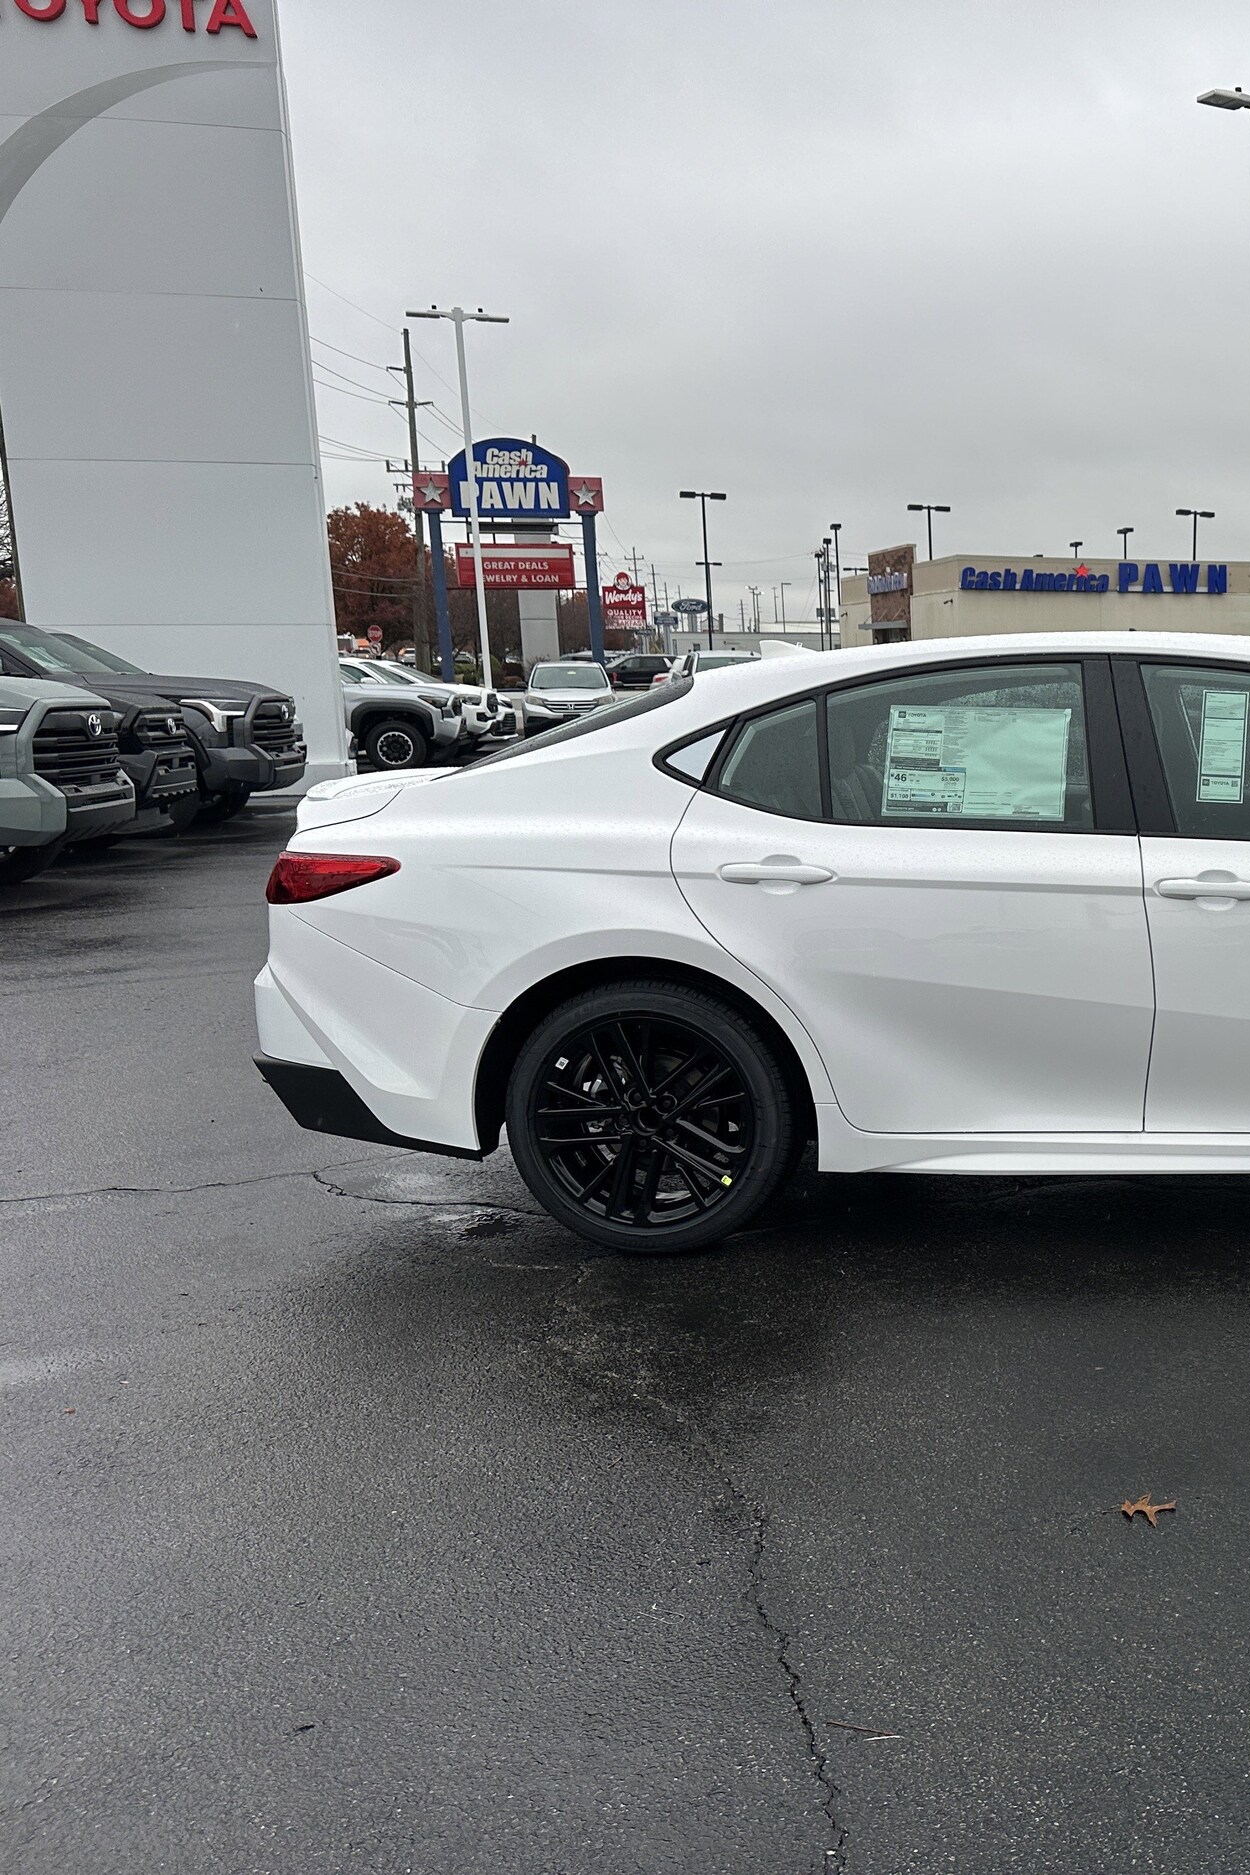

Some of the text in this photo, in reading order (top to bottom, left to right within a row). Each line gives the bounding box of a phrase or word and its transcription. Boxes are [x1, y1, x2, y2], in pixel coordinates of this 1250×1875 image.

[486, 448, 533, 465] Cash
[473, 461, 548, 478] America
[483, 561, 549, 570] GREAT DEALS
[482, 574, 559, 583] EWELRY & LOAN
[961, 562, 1227, 593] Cash America PAWN
[605, 589, 643, 605] Wendy's
[680, 601, 703, 611] Ford
[894, 773, 907, 782] 46
